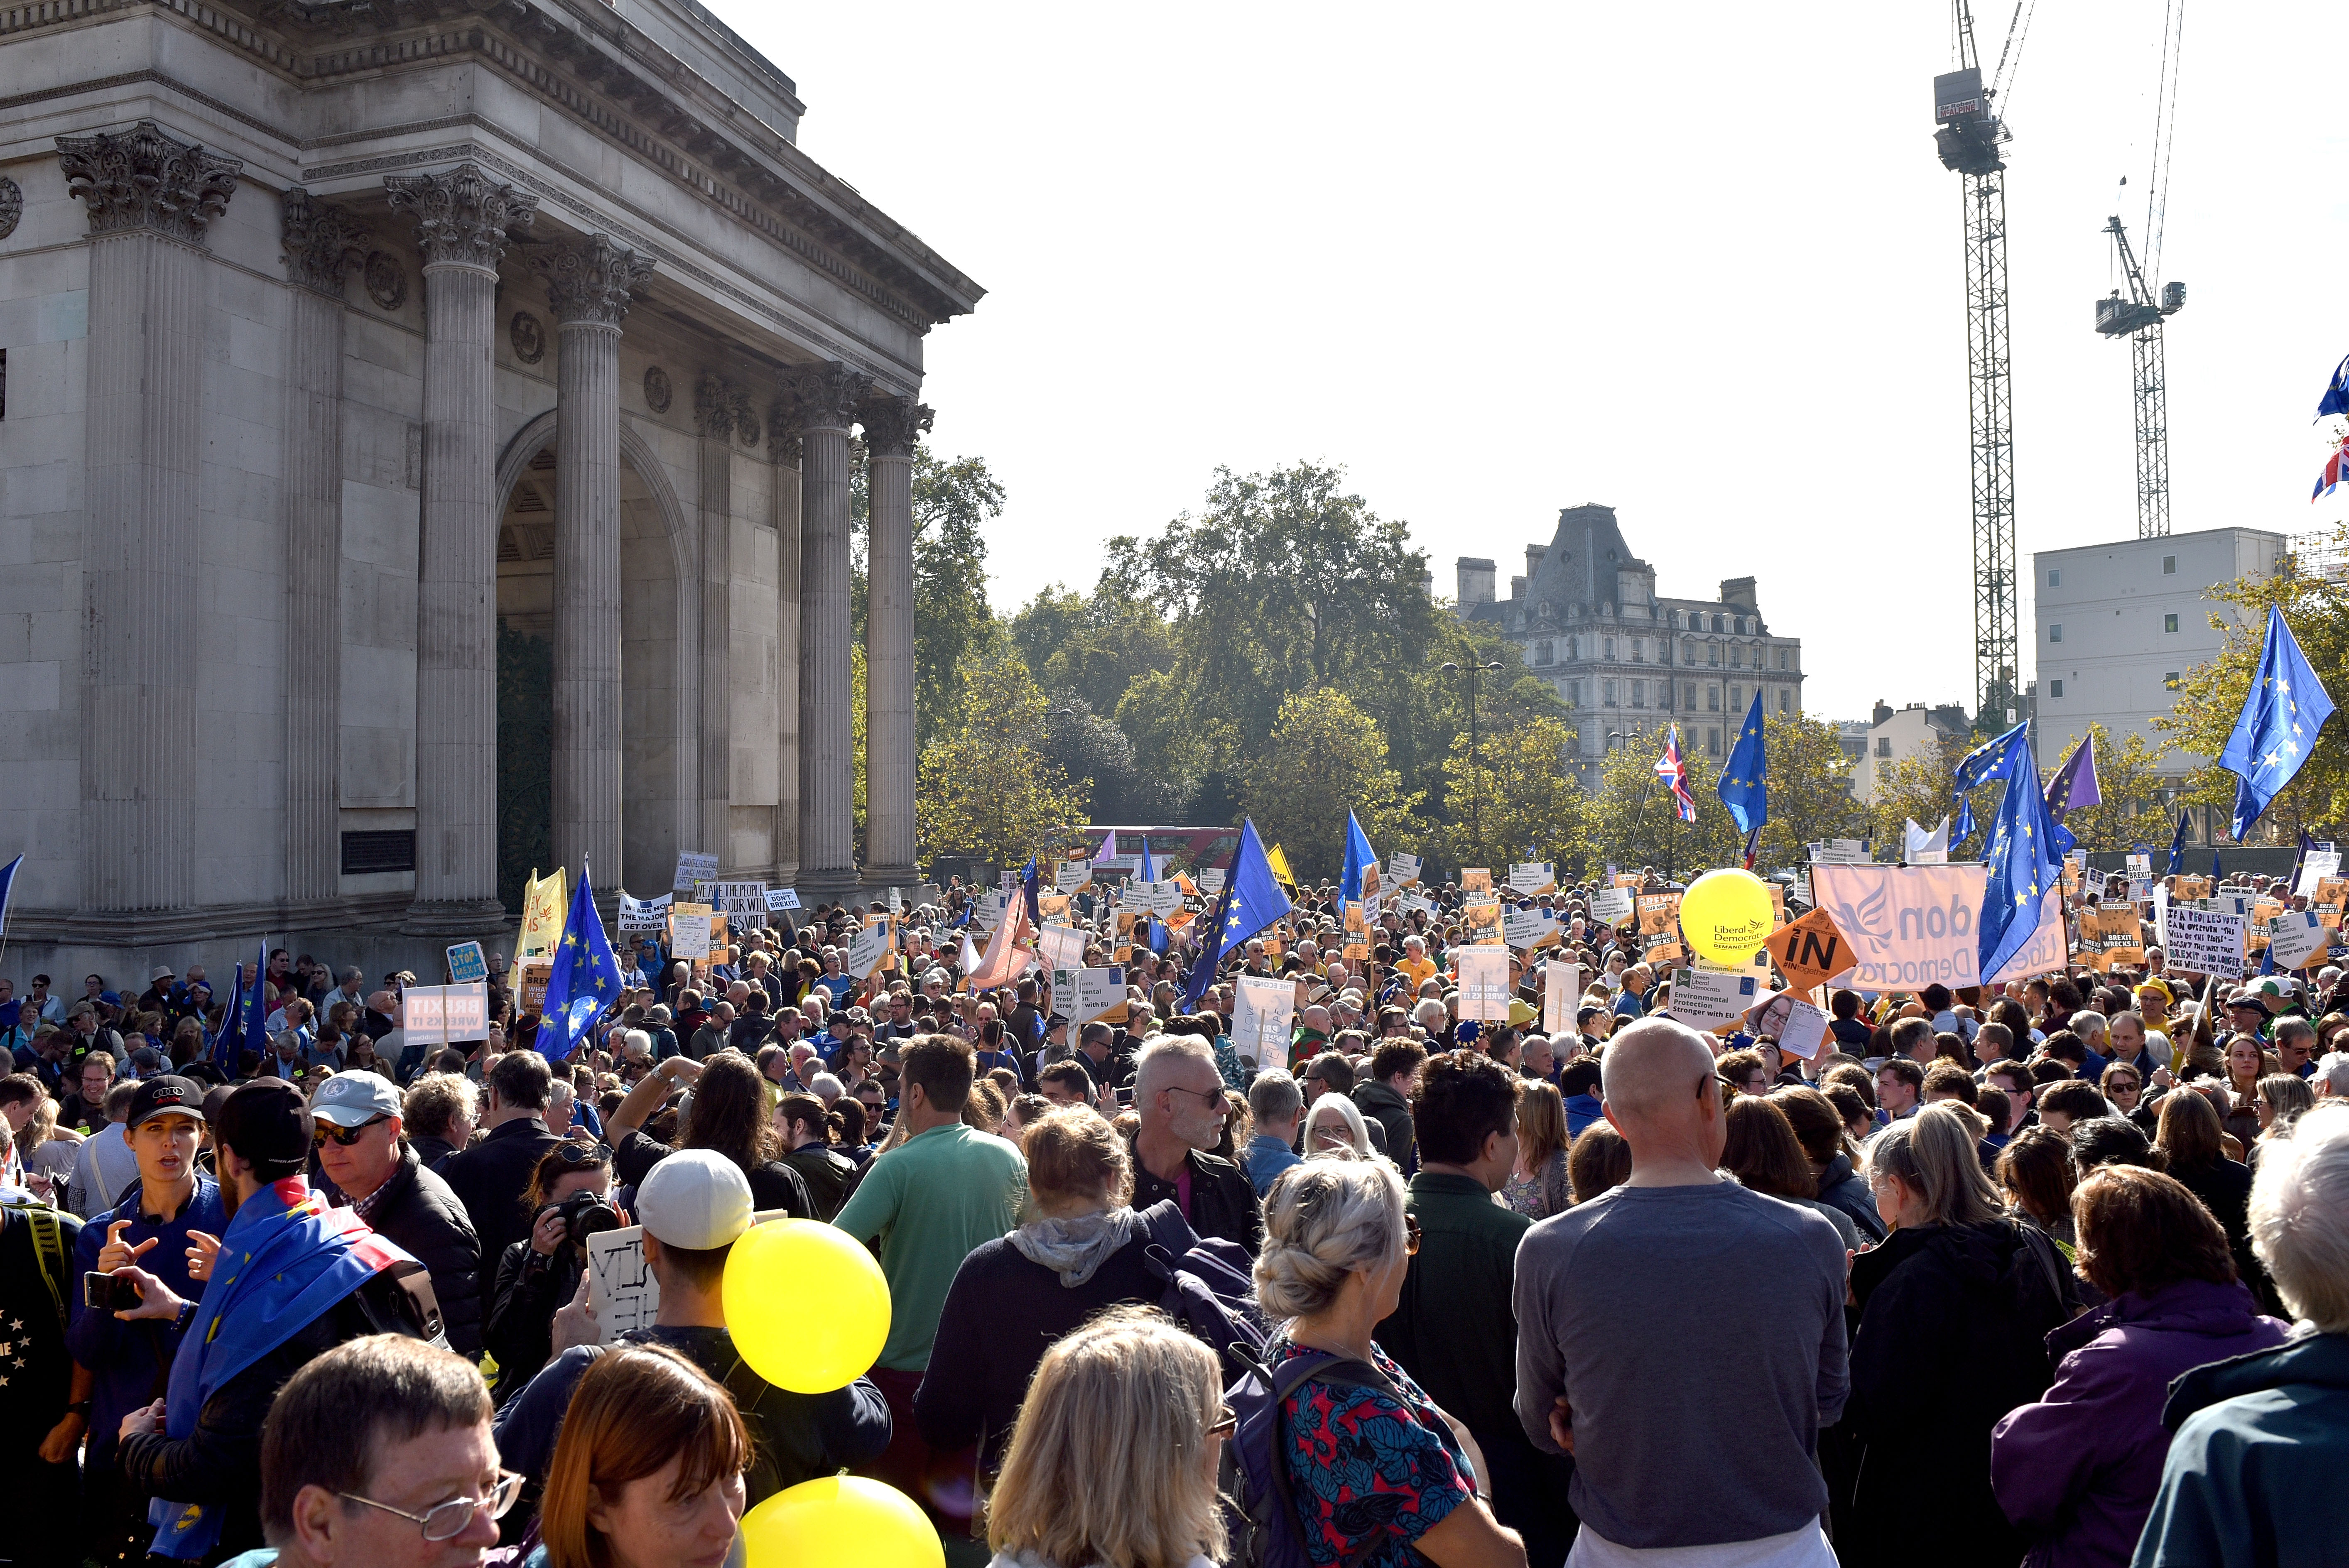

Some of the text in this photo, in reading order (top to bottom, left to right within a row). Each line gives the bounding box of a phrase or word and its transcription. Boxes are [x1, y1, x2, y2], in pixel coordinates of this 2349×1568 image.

[1951, 100, 1975, 108] Robert
[695, 885, 706, 897] WE
[725, 884, 738, 897] THE
[740, 884, 764, 897] PEOPLE
[654, 903, 672, 911] NOW
[729, 899, 744, 912] OUR
[748, 898, 767, 912] WILL
[1184, 903, 1202, 911] rats
[2168, 909, 2239, 924] IF A PEOPLE'S VOTE
[1506, 924, 1538, 932] Environmental
[2168, 920, 2185, 930] CAN
[2187, 924, 2217, 933] OVERTURN
[1715, 932, 1763, 941] Democrats
[2168, 930, 2182, 938] WILL
[2273, 933, 2304, 944] Environmental
[1646, 938, 1670, 947] WRECKS
[2275, 943, 2296, 951] Protection
[2169, 949, 2199, 960] BREXIT
[2218, 956, 2240, 967] LONGER
[1783, 962, 1829, 977] #INtogether
[2185, 961, 2199, 969] WILL
[2221, 965, 2242, 980] PEOPLE?
[1675, 992, 1728, 1003] Environmental
[1674, 999, 1712, 1008] Protection
[1673, 1007, 1704, 1016] Stronger
[1243, 1002, 1254, 1033] LOVE
[1266, 1008, 1284, 1059] EUROPE
